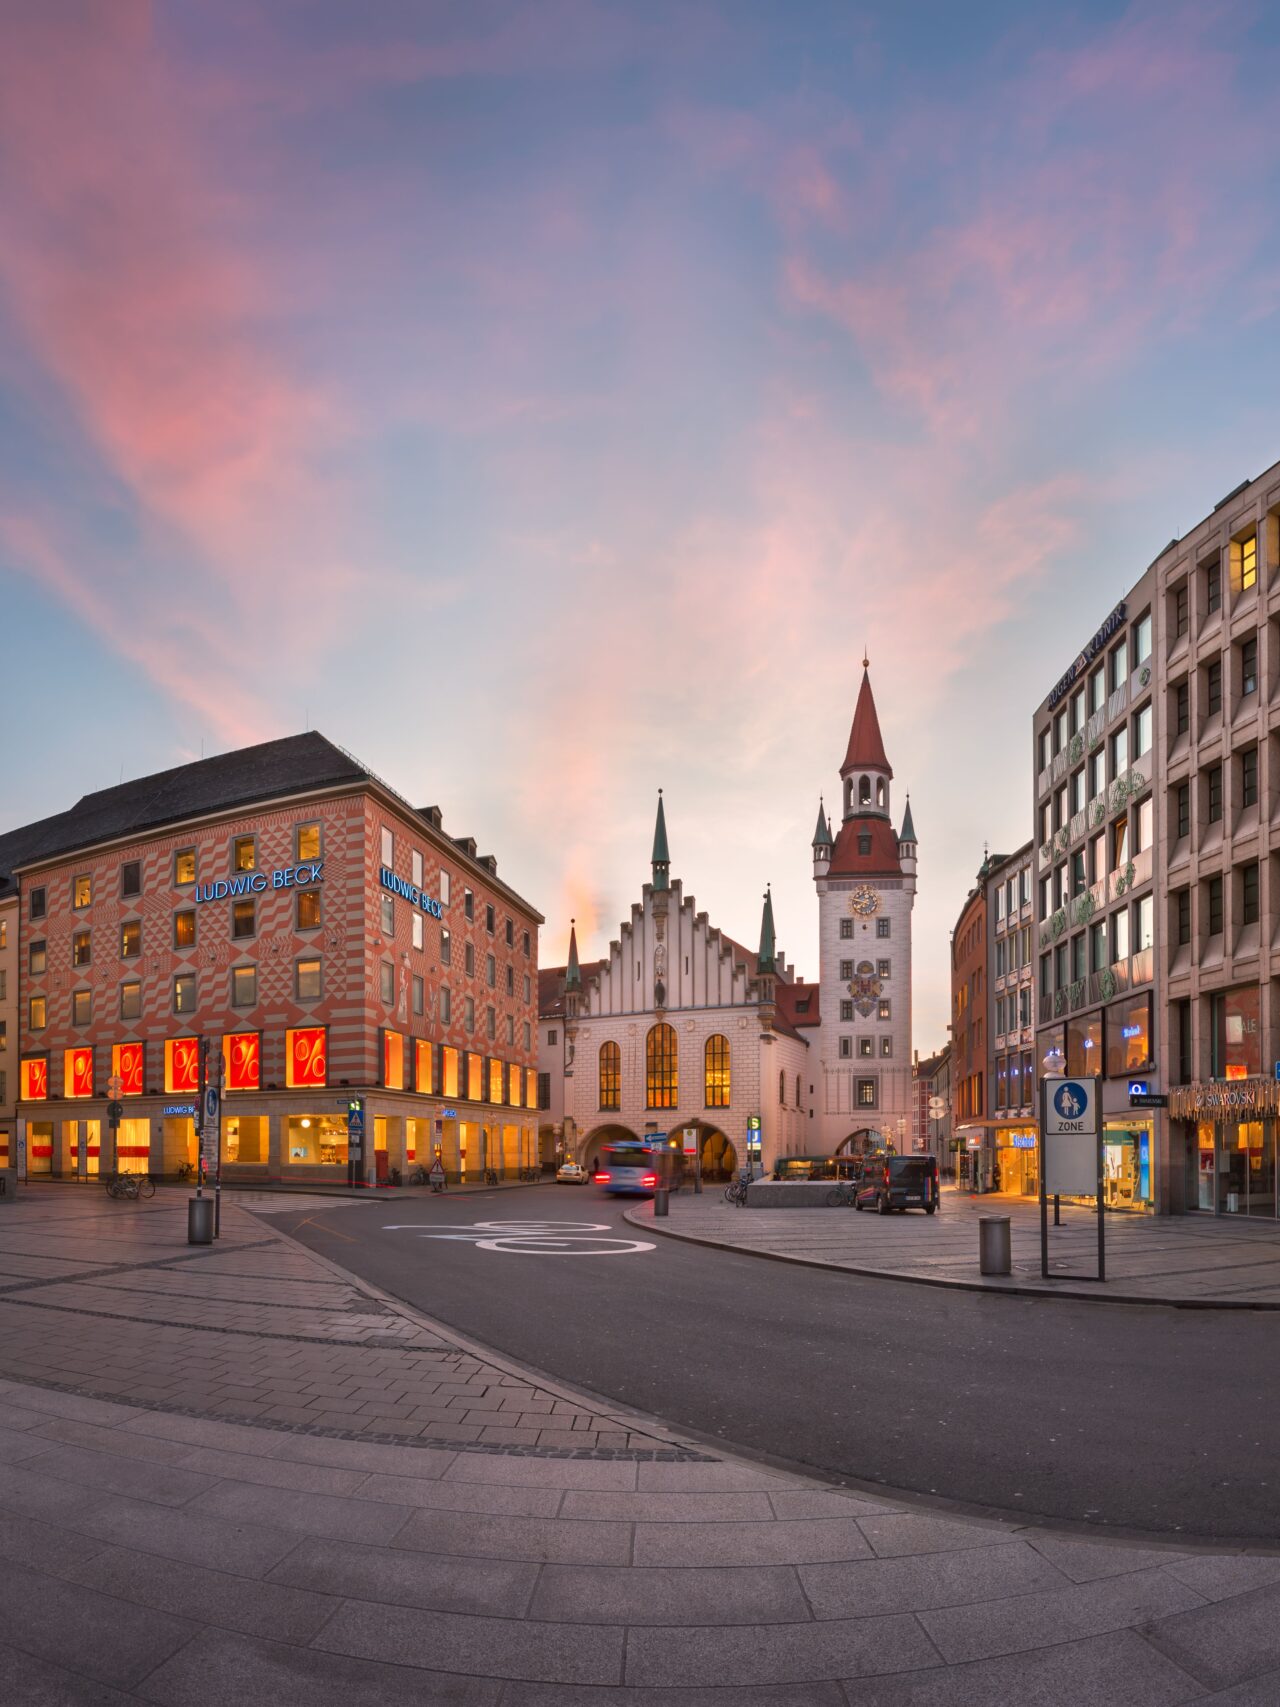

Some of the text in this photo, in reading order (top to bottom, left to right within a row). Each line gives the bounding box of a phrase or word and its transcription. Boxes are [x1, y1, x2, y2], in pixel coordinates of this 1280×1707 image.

[1047, 606, 1123, 707] AUGEN KLINIK
[195, 863, 325, 903] LUDWIG BECK
[381, 867, 443, 920] LUDWIG BECK
[1207, 1091, 1255, 1107] SWAROVSKI
[163, 1106, 187, 1115] LUDWIG
[750, 1117, 760, 1130] S
[1058, 1121, 1085, 1132] ZONE
